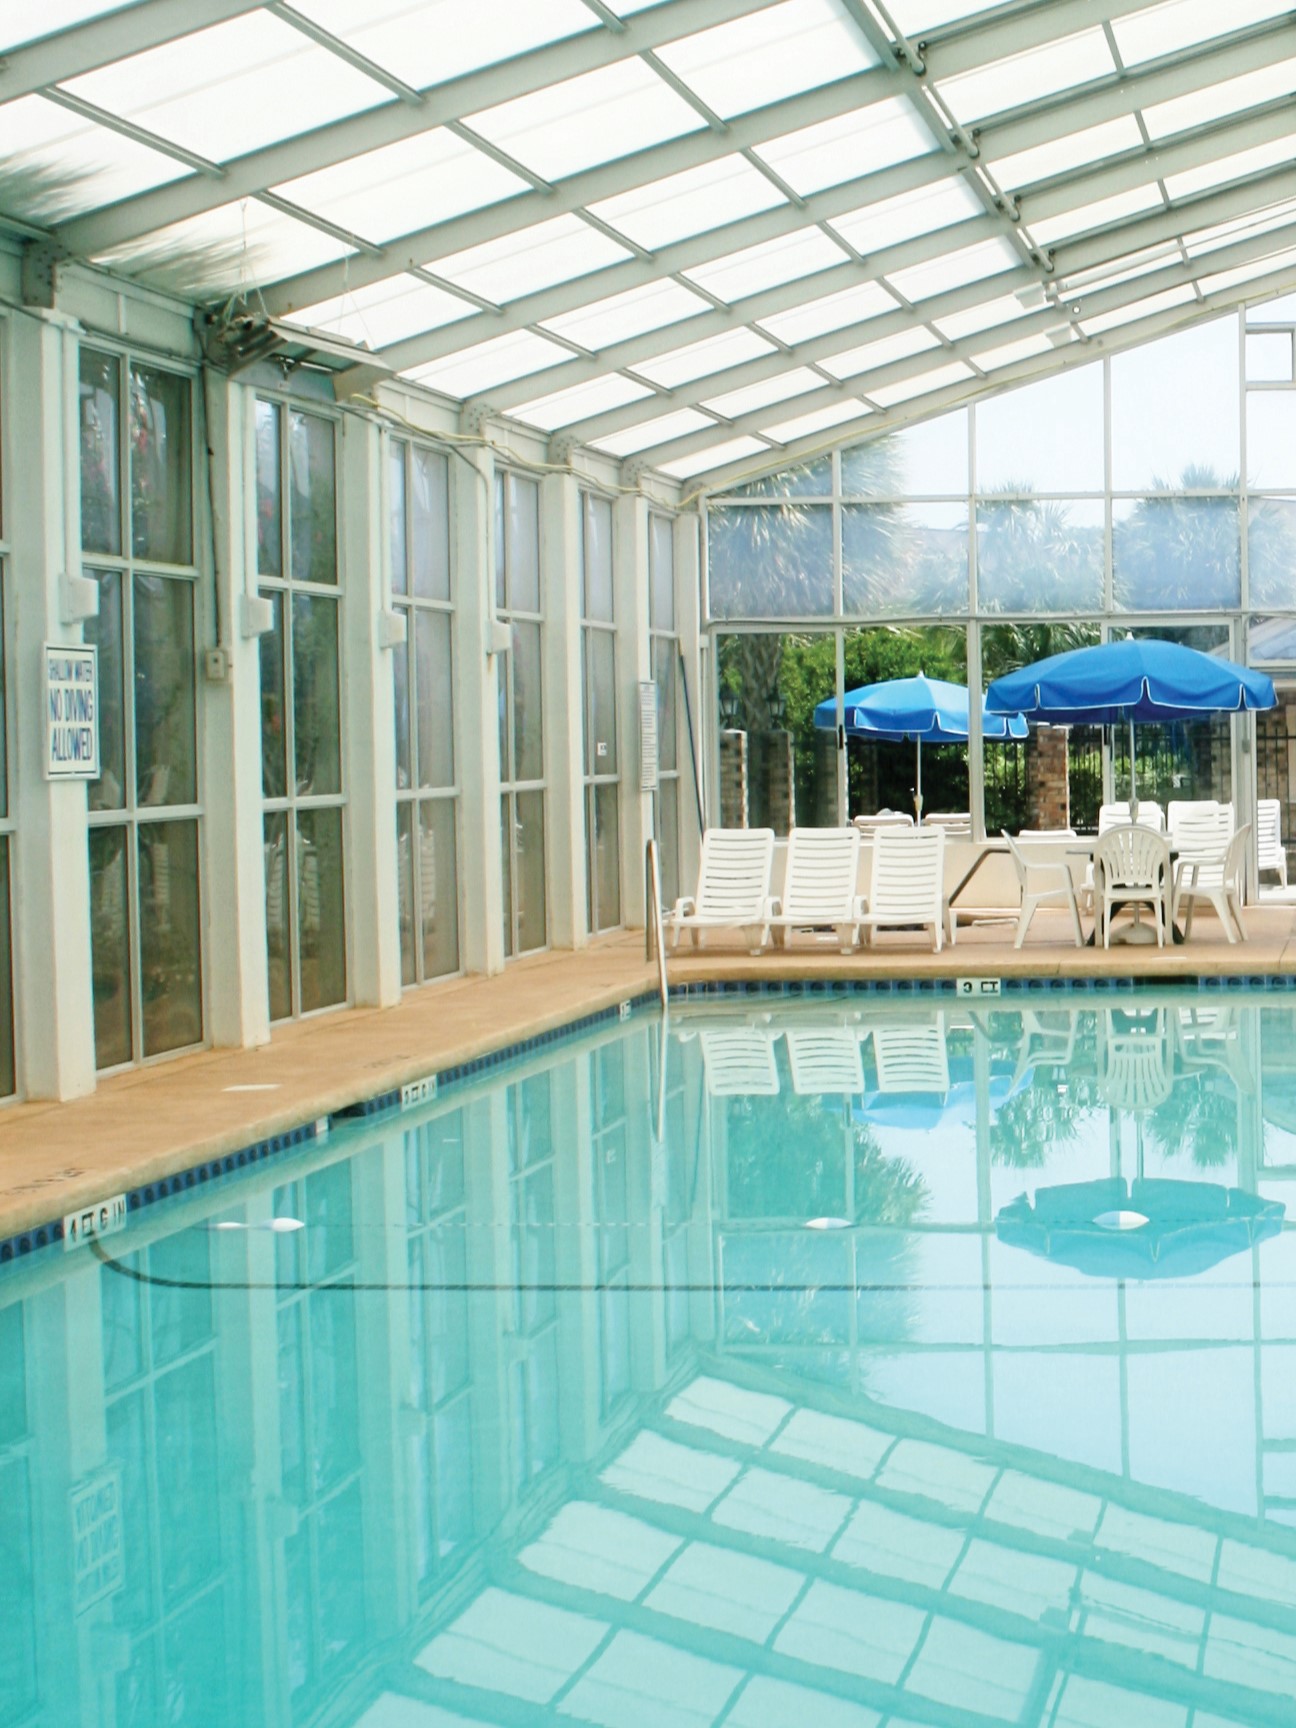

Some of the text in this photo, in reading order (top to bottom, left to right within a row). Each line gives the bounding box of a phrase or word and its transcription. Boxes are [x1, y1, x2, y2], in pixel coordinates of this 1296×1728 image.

[50, 688, 93, 722] NO DIVING
[51, 727, 93, 761] ALLOWED
